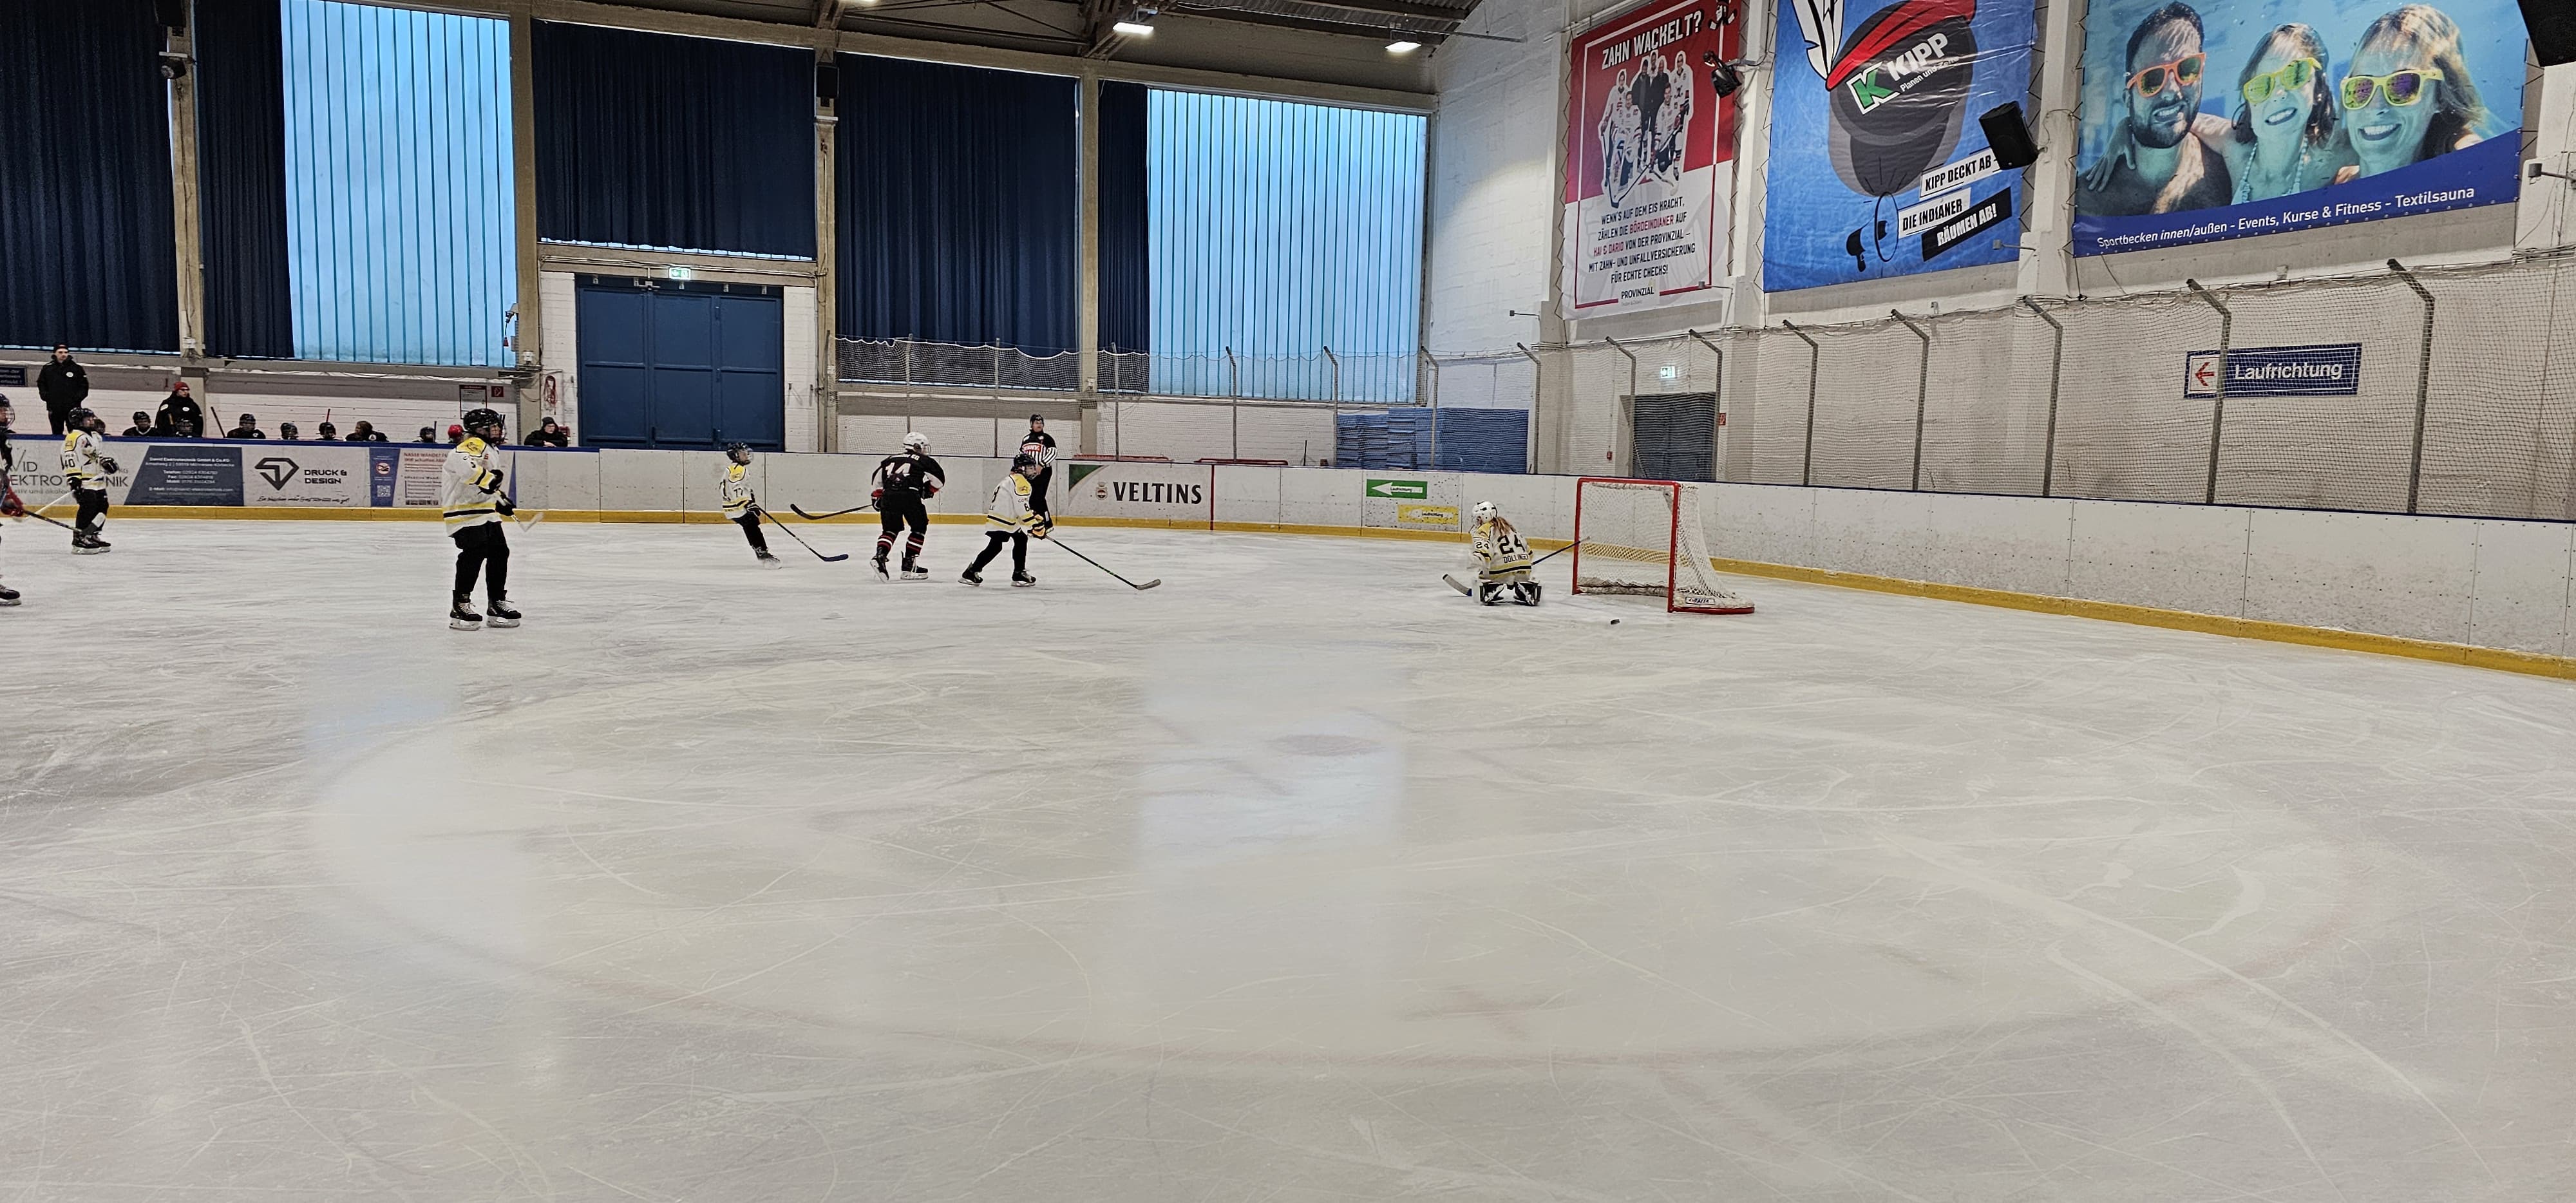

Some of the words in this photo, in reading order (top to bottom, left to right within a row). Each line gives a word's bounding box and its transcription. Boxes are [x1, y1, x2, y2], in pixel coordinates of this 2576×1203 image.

[1602, 39, 1630, 70] ZAHN
[1633, 10, 1701, 57] WACKELT?
[1887, 33, 1948, 81] KIPP
[1900, 74, 1924, 92] Planen
[1926, 173, 1946, 191] KIPP
[1947, 160, 1976, 183] DECKT
[1979, 155, 1991, 171] AB
[1601, 209, 1622, 225] WENN'S
[1623, 209, 1634, 220] AUF
[1635, 205, 1647, 217] DEM
[1648, 202, 1658, 214] EIS
[1902, 214, 1917, 231] DIE
[1919, 198, 1962, 225] INDIANER
[1937, 213, 1978, 247] RÄUMEN
[1979, 203, 1997, 225] AB!
[2097, 232, 2158, 249] Sportbecken
[2160, 223, 2227, 240] innen/außen
[2239, 214, 2279, 231] Events,
[2282, 211, 2318, 223] Kurse
[2322, 205, 2332, 218] &
[2335, 200, 2382, 216] Fitness
[2395, 187, 2474, 207] Textilsauna
[1598, 225, 1618, 241] ZÄHLEN
[1619, 225, 1629, 236] DIE
[1629, 214, 1674, 234] BÖRDEINDIANER
[1676, 211, 1687, 223] AUF
[1625, 238, 1636, 250] VON
[1638, 236, 1649, 248] DER
[1650, 229, 1684, 245] PROVINZIAL
[1589, 261, 1598, 272] MIT
[1600, 260, 1616, 270] ZAHN-
[1617, 256, 1627, 267] UND
[1629, 243, 1696, 265] UNFALLVERSICHERUNG
[1611, 270, 1622, 283] FÜR
[1623, 268, 1642, 281] ECHTE
[1621, 287, 1654, 299] PROVINZIAL
[2235, 362, 2342, 380] Laufrichtung
[886, 462, 911, 478] 14
[1113, 481, 1202, 504] VELTINS
[1497, 534, 1526, 554] 24
